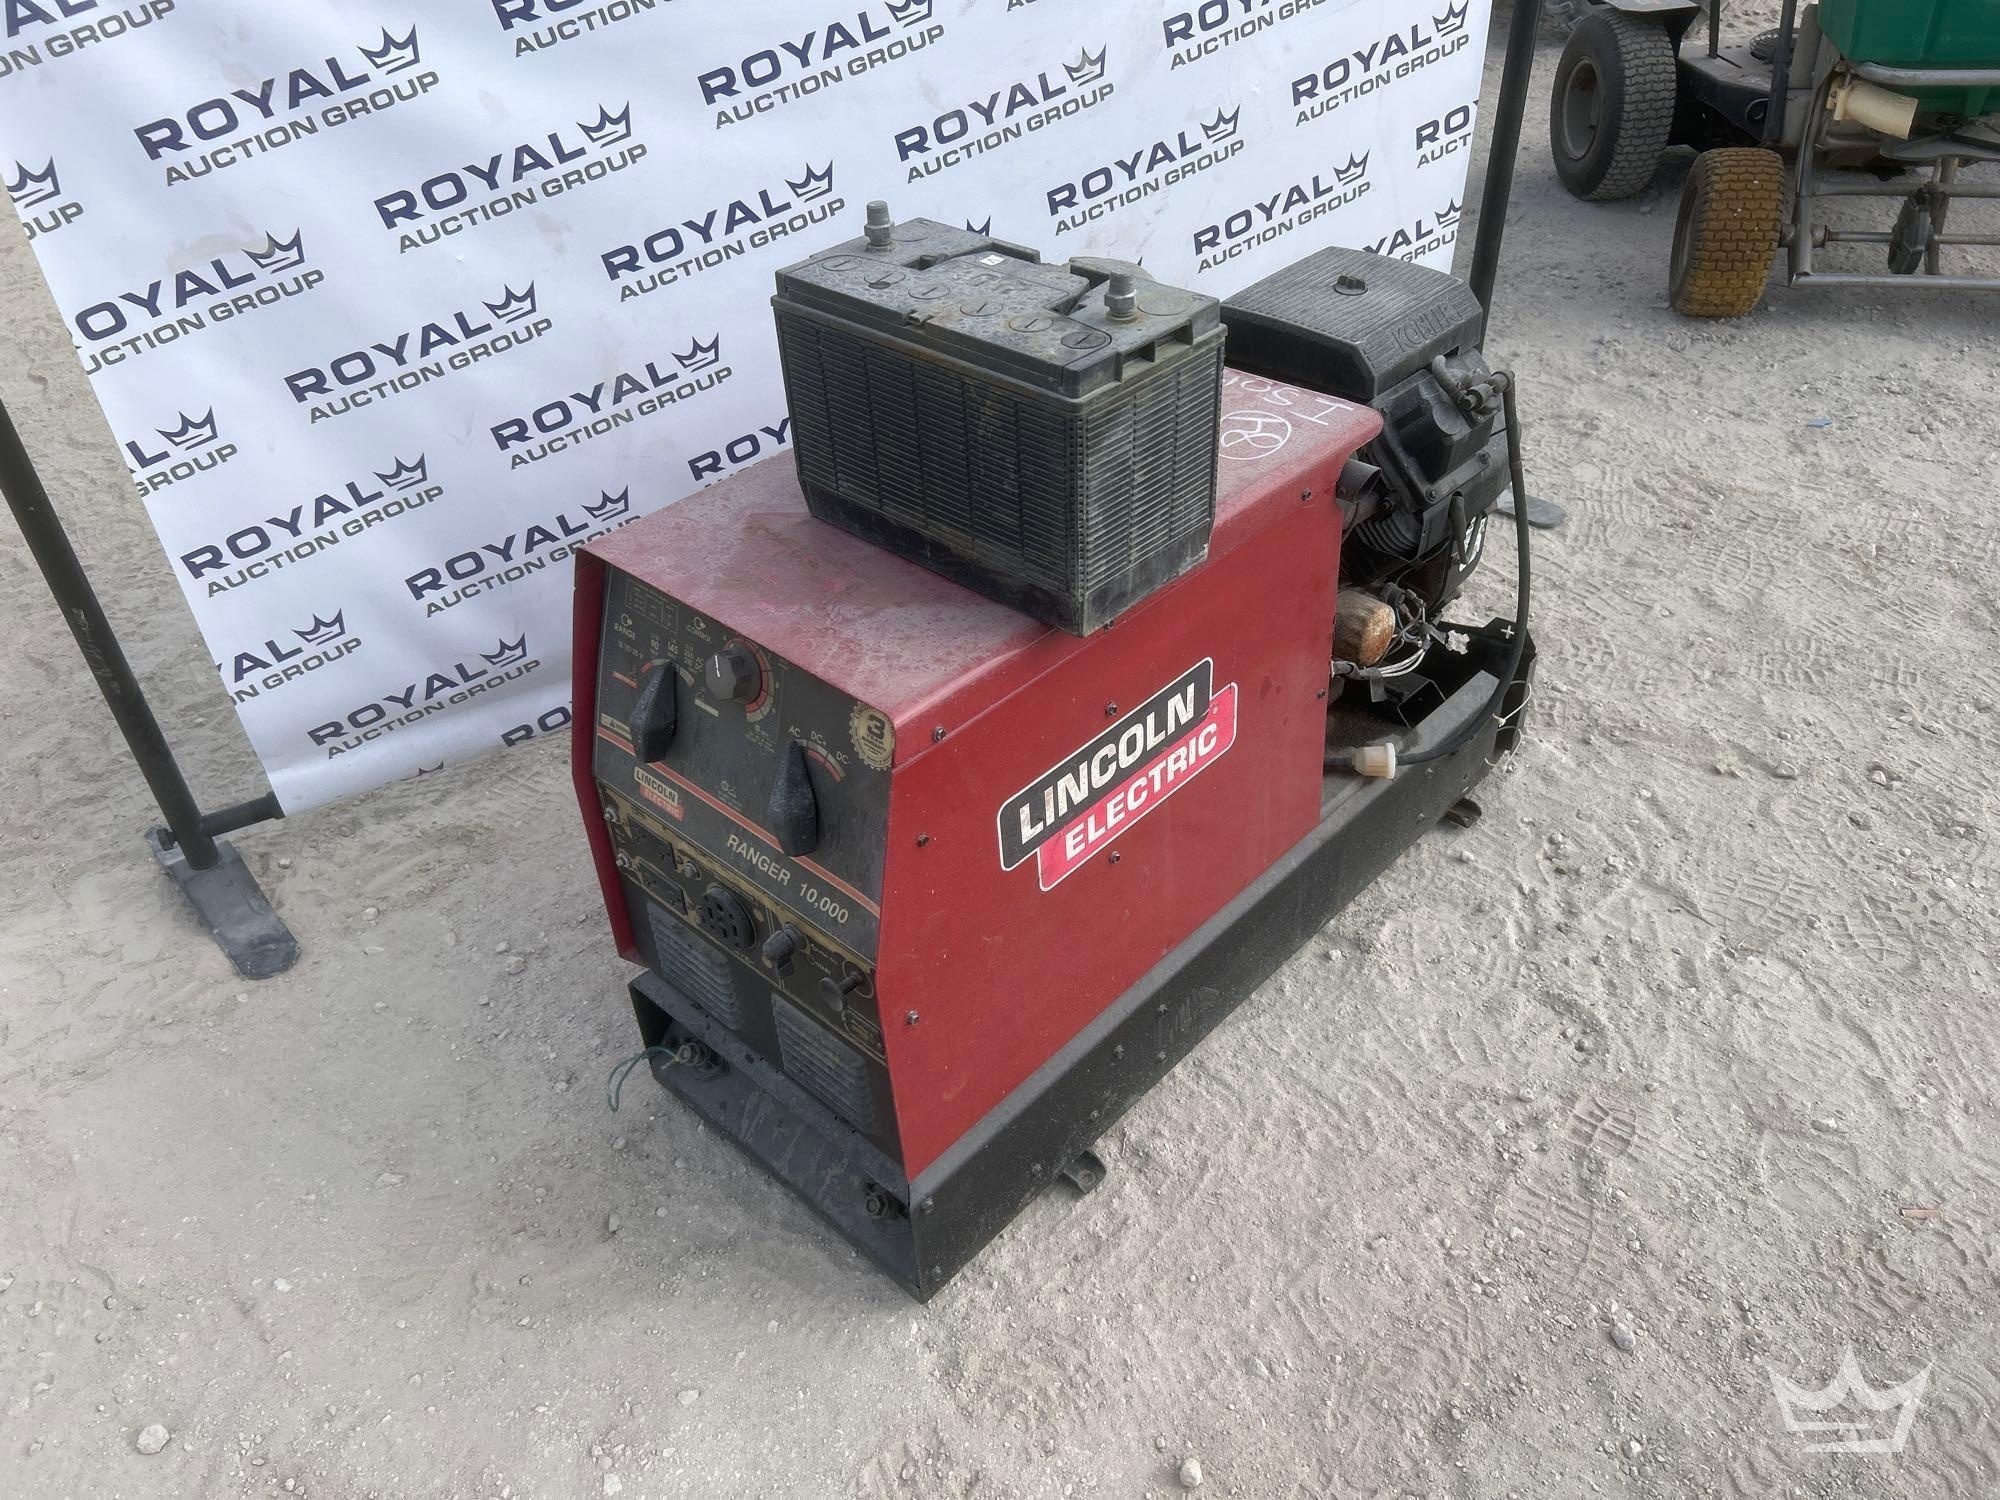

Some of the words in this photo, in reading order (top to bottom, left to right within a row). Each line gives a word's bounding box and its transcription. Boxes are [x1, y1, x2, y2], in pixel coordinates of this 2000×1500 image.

[44, 0, 176, 57] GROUP
[697, 11, 891, 106] ROYAL
[1170, 11, 1274, 71] AUCTION
[1291, 24, 1432, 106] ROYAL
[133, 57, 371, 160] ROYAL
[716, 65, 844, 129] AUCTION
[847, 24, 945, 76] GROUP
[894, 72, 1067, 162] ROYAL
[1295, 70, 1391, 127] AUCTION
[1395, 34, 1470, 79] GROUP
[166, 115, 319, 187] AUCTION
[321, 71, 440, 128] GROUP
[907, 122, 1022, 184] AUCTION
[1026, 83, 1115, 132] GROUP
[1046, 131, 1202, 216] ROYAL
[373, 132, 587, 230] ROYAL
[399, 188, 538, 254] AUCTION
[541, 143, 648, 198] GROUP
[1055, 177, 1160, 236] AUCTION
[1164, 139, 1245, 186] GROUP
[1193, 175, 1334, 256] ROYAL
[601, 189, 792, 281] ROYAL
[620, 239, 745, 303] AUCTION
[749, 198, 846, 249] GROUP
[1198, 218, 1293, 274] AUCTION
[1298, 181, 1371, 226] GROUP
[70, 258, 257, 349] OYAL
[208, 269, 325, 322] GROUP
[283, 311, 492, 403] ROYAL
[310, 362, 446, 424] AUCTION
[448, 318, 553, 371] GROUP
[490, 362, 680, 451] ROYAL
[510, 408, 634, 470] AUCTION
[637, 366, 733, 417] GROUP
[180, 481, 384, 580] ROYAL
[208, 530, 340, 598] AUCTION
[343, 485, 445, 537] GROUP
[405, 514, 590, 601] ROYAL
[426, 556, 546, 619] AUCTION
[262, 637, 362, 690] GROUP
[307, 662, 488, 746] ROYAL
[327, 700, 445, 760] AUCTION
[448, 659, 541, 705] GROUP
[788, 725, 801, 738] AC
[866, 714, 886, 739] 3
[1019, 682, 1195, 845] LINCOLN
[636, 769, 677, 803] LINCOLN
[644, 789, 682, 818] ELECTRIC
[1065, 722, 1217, 861] ELECTRIC
[726, 834, 791, 886] RANGER
[799, 882, 849, 924] 10,000
